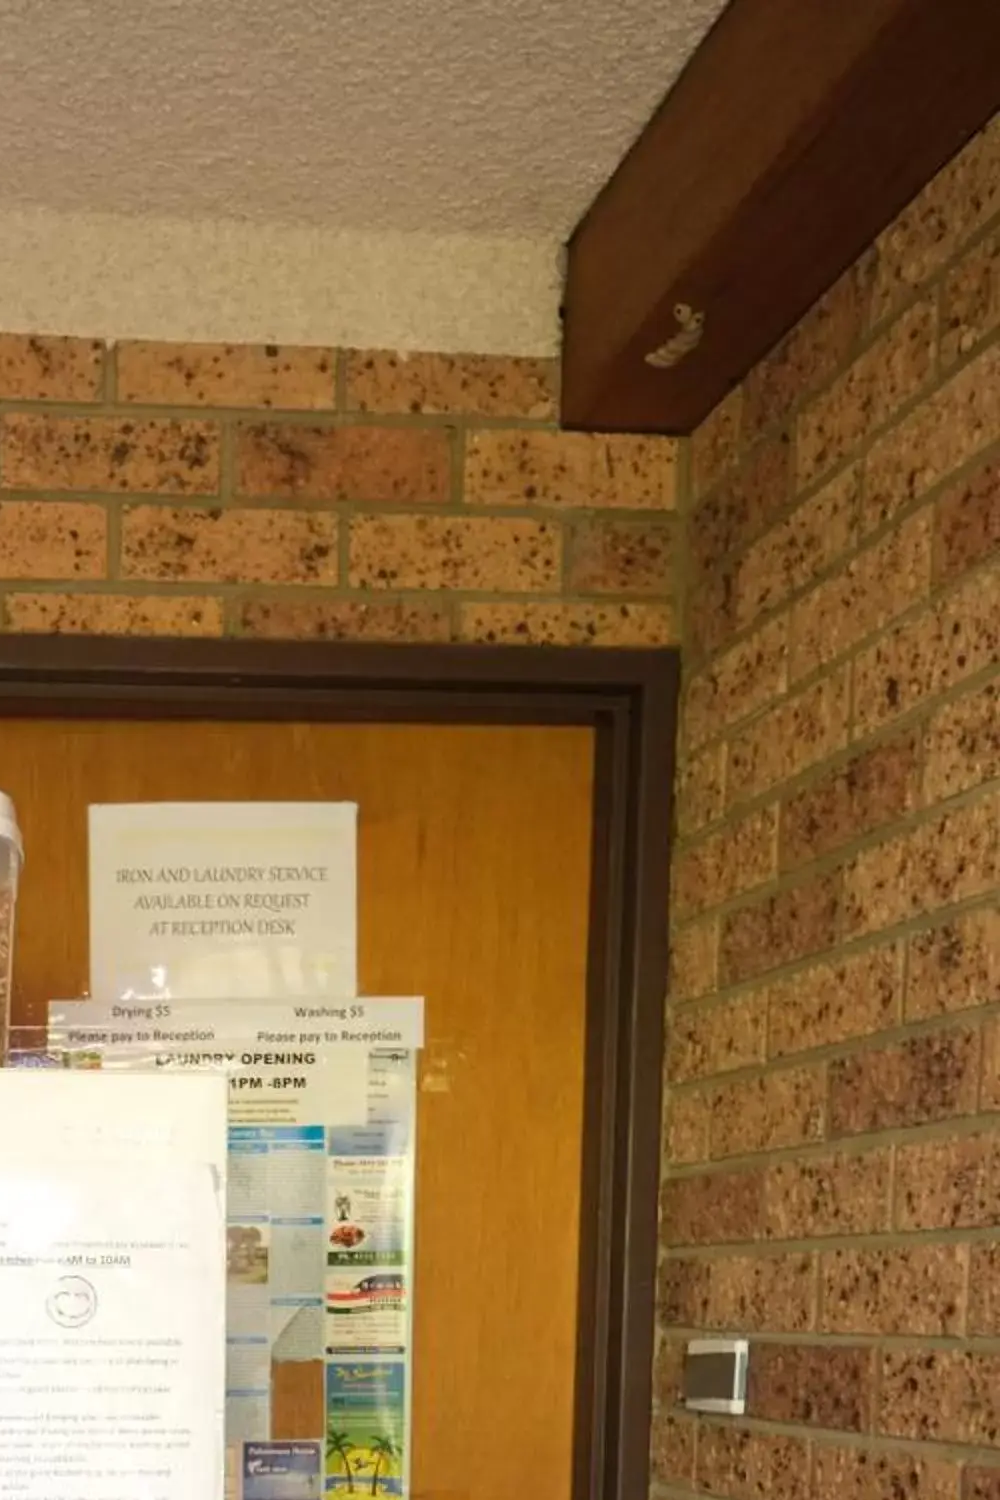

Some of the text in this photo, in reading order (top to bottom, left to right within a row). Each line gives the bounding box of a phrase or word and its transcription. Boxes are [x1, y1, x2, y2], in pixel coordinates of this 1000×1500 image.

[116, 866, 329, 883] IRON AND LAUNDRY SERVICE
[134, 893, 311, 912] AVAILABLE ON REQUEST
[150, 919, 296, 936] AT RECEPTION DESK
[112, 1005, 170, 1019] Drying $5
[294, 1006, 365, 1019] Washing $5
[68, 1030, 215, 1043] Please pay to Reception
[257, 1031, 402, 1044] Please pay to Reception
[241, 1053, 316, 1065] OPENING
